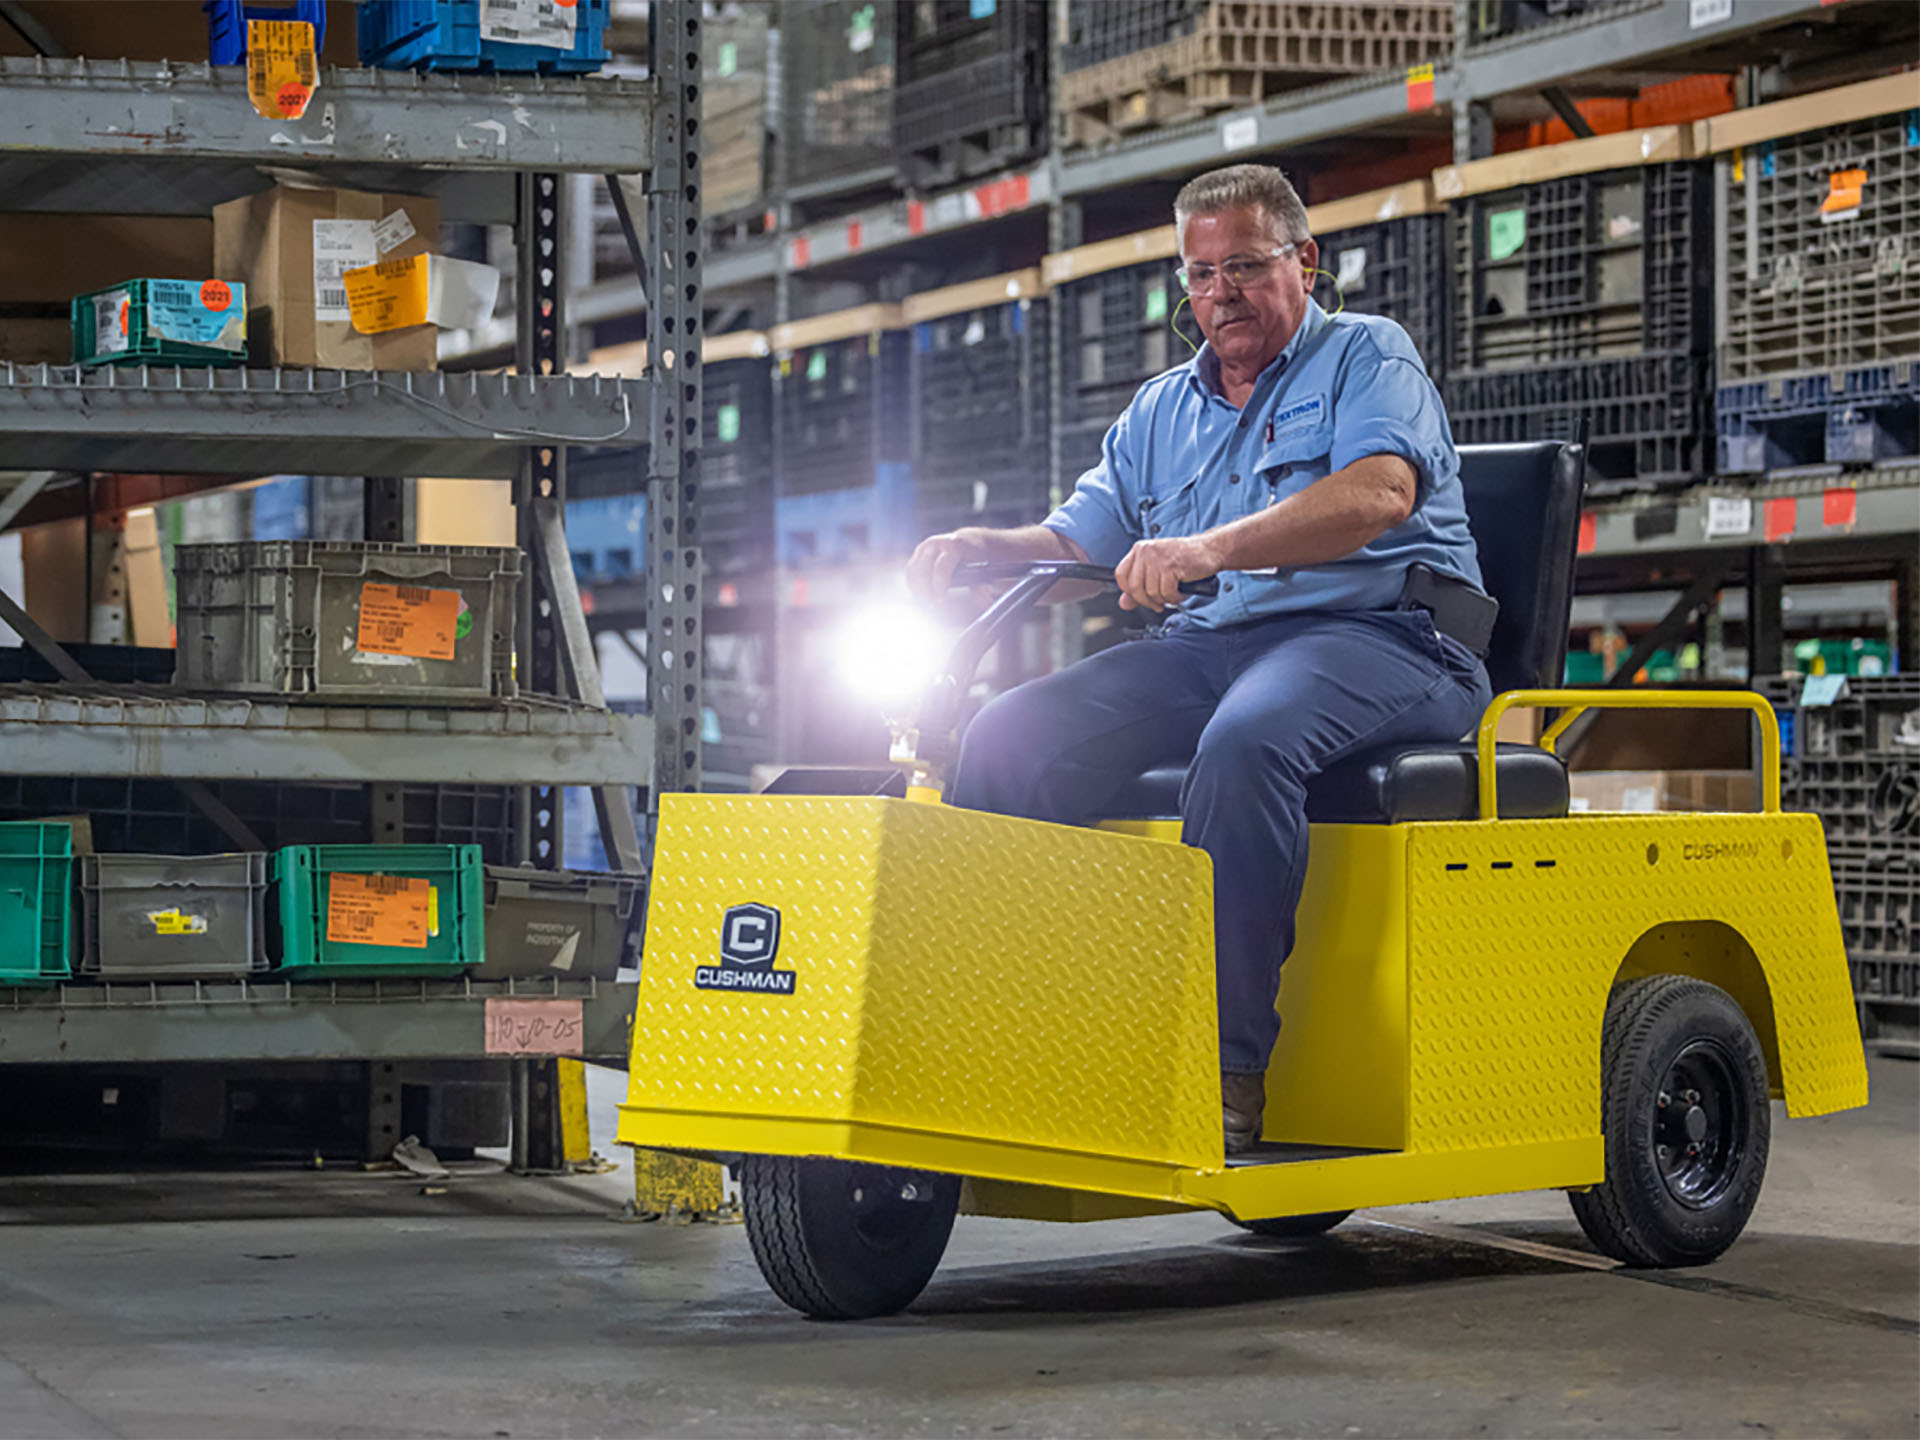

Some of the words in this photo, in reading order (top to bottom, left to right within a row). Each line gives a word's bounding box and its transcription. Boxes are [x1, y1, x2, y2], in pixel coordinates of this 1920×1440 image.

[202, 289, 230, 302] 2021
[1682, 842, 1759, 861] CUSHMAN
[728, 915, 767, 953] C
[695, 968, 792, 989] CUSHMAN
